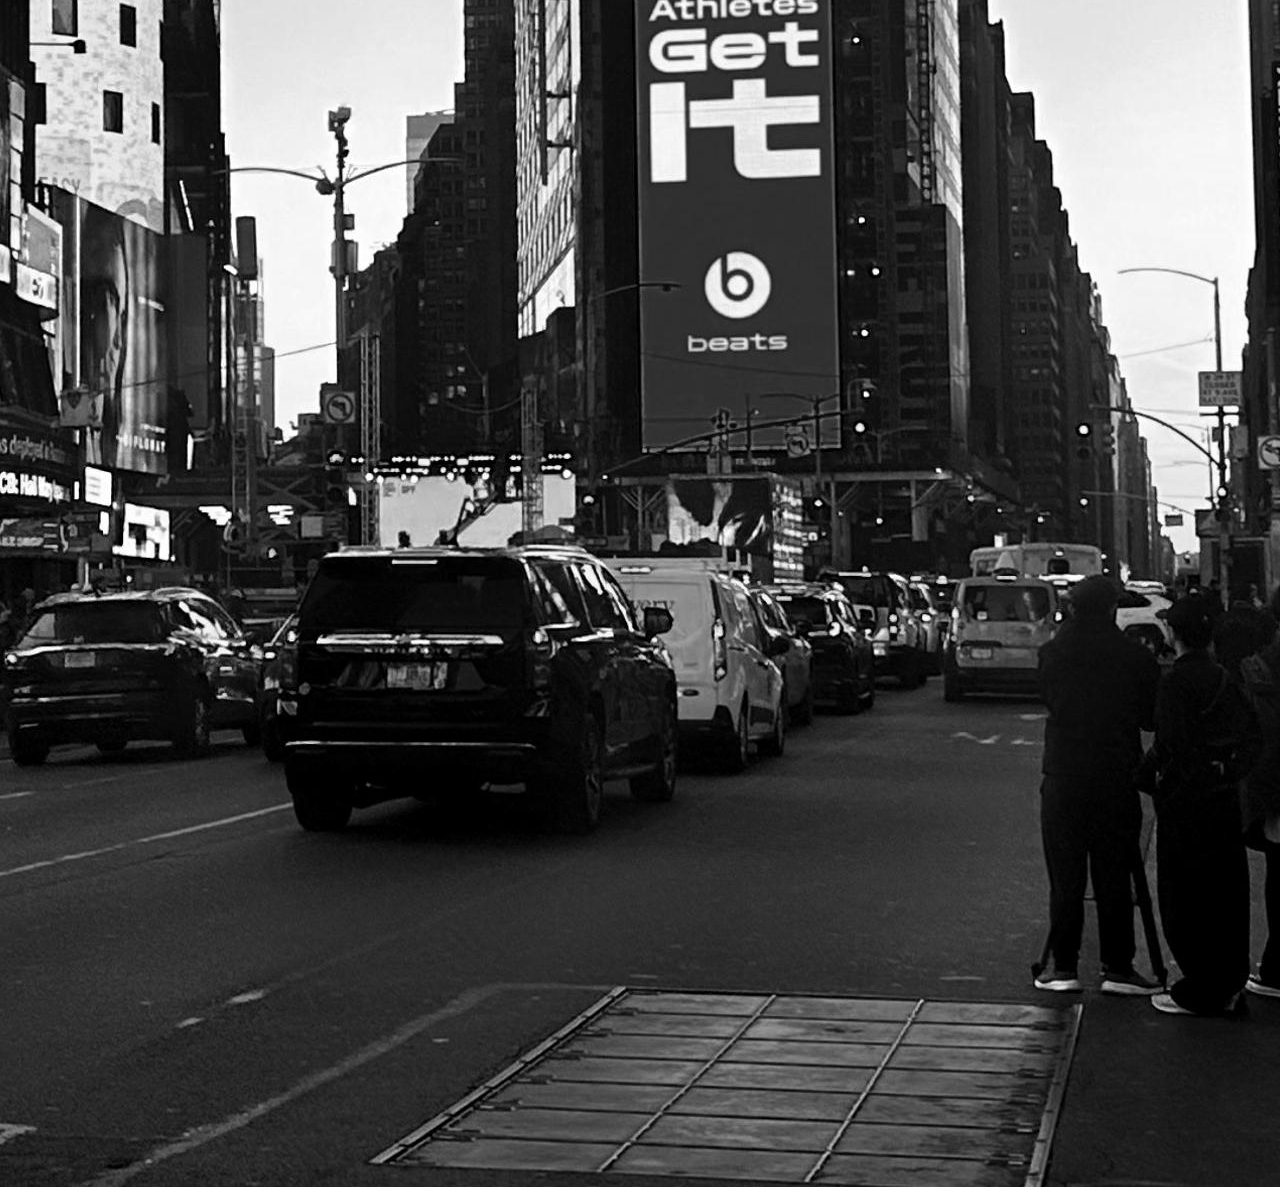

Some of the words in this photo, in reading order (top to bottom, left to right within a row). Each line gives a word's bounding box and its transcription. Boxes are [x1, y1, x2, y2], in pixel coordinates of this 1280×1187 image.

[648, 22, 820, 74] Get
[649, 78, 822, 183] It
[687, 333, 788, 353] beats
